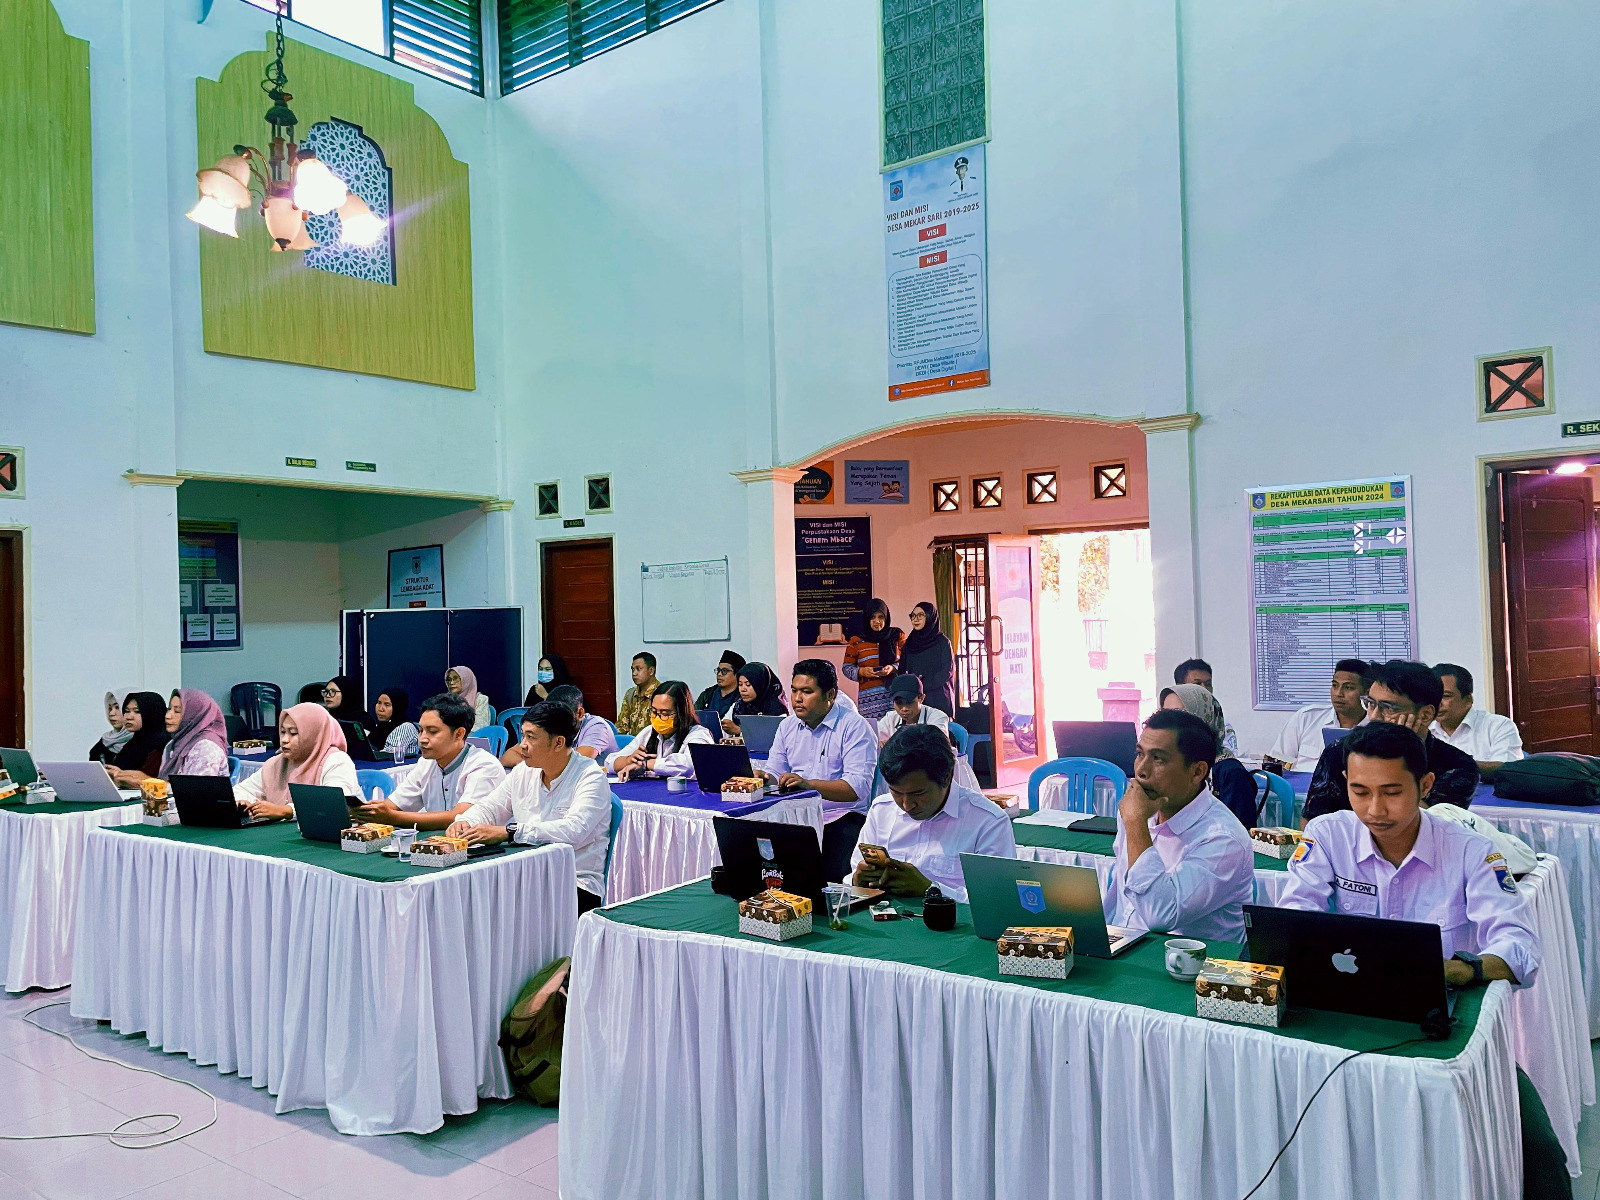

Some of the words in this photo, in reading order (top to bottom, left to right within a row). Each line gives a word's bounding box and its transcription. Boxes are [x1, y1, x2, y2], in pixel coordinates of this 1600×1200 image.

[886, 212, 899, 222] VISI
[900, 209, 914, 218] DAN
[915, 204, 929, 214] MISI
[887, 222, 903, 233] DESA
[904, 216, 926, 229] MEKAR
[927, 212, 943, 223] SARI
[943, 202, 980, 219] 2019-2025
[926, 228, 939, 237] VISI
[1566, 425, 1577, 434] R.
[1270, 490, 1314, 501] REKAPITULASI
[1314, 488, 1331, 497] DATA
[1331, 484, 1384, 496] KEPENDUDUKAN
[1270, 500, 1290, 508] DESA
[1291, 497, 1335, 507] MEKARSARI
[1337, 494, 1364, 503] TAHUN
[1365, 493, 1384, 501] 2024
[1004, 647, 1028, 659] DENGAN
[1342, 881, 1372, 893] FATONI
